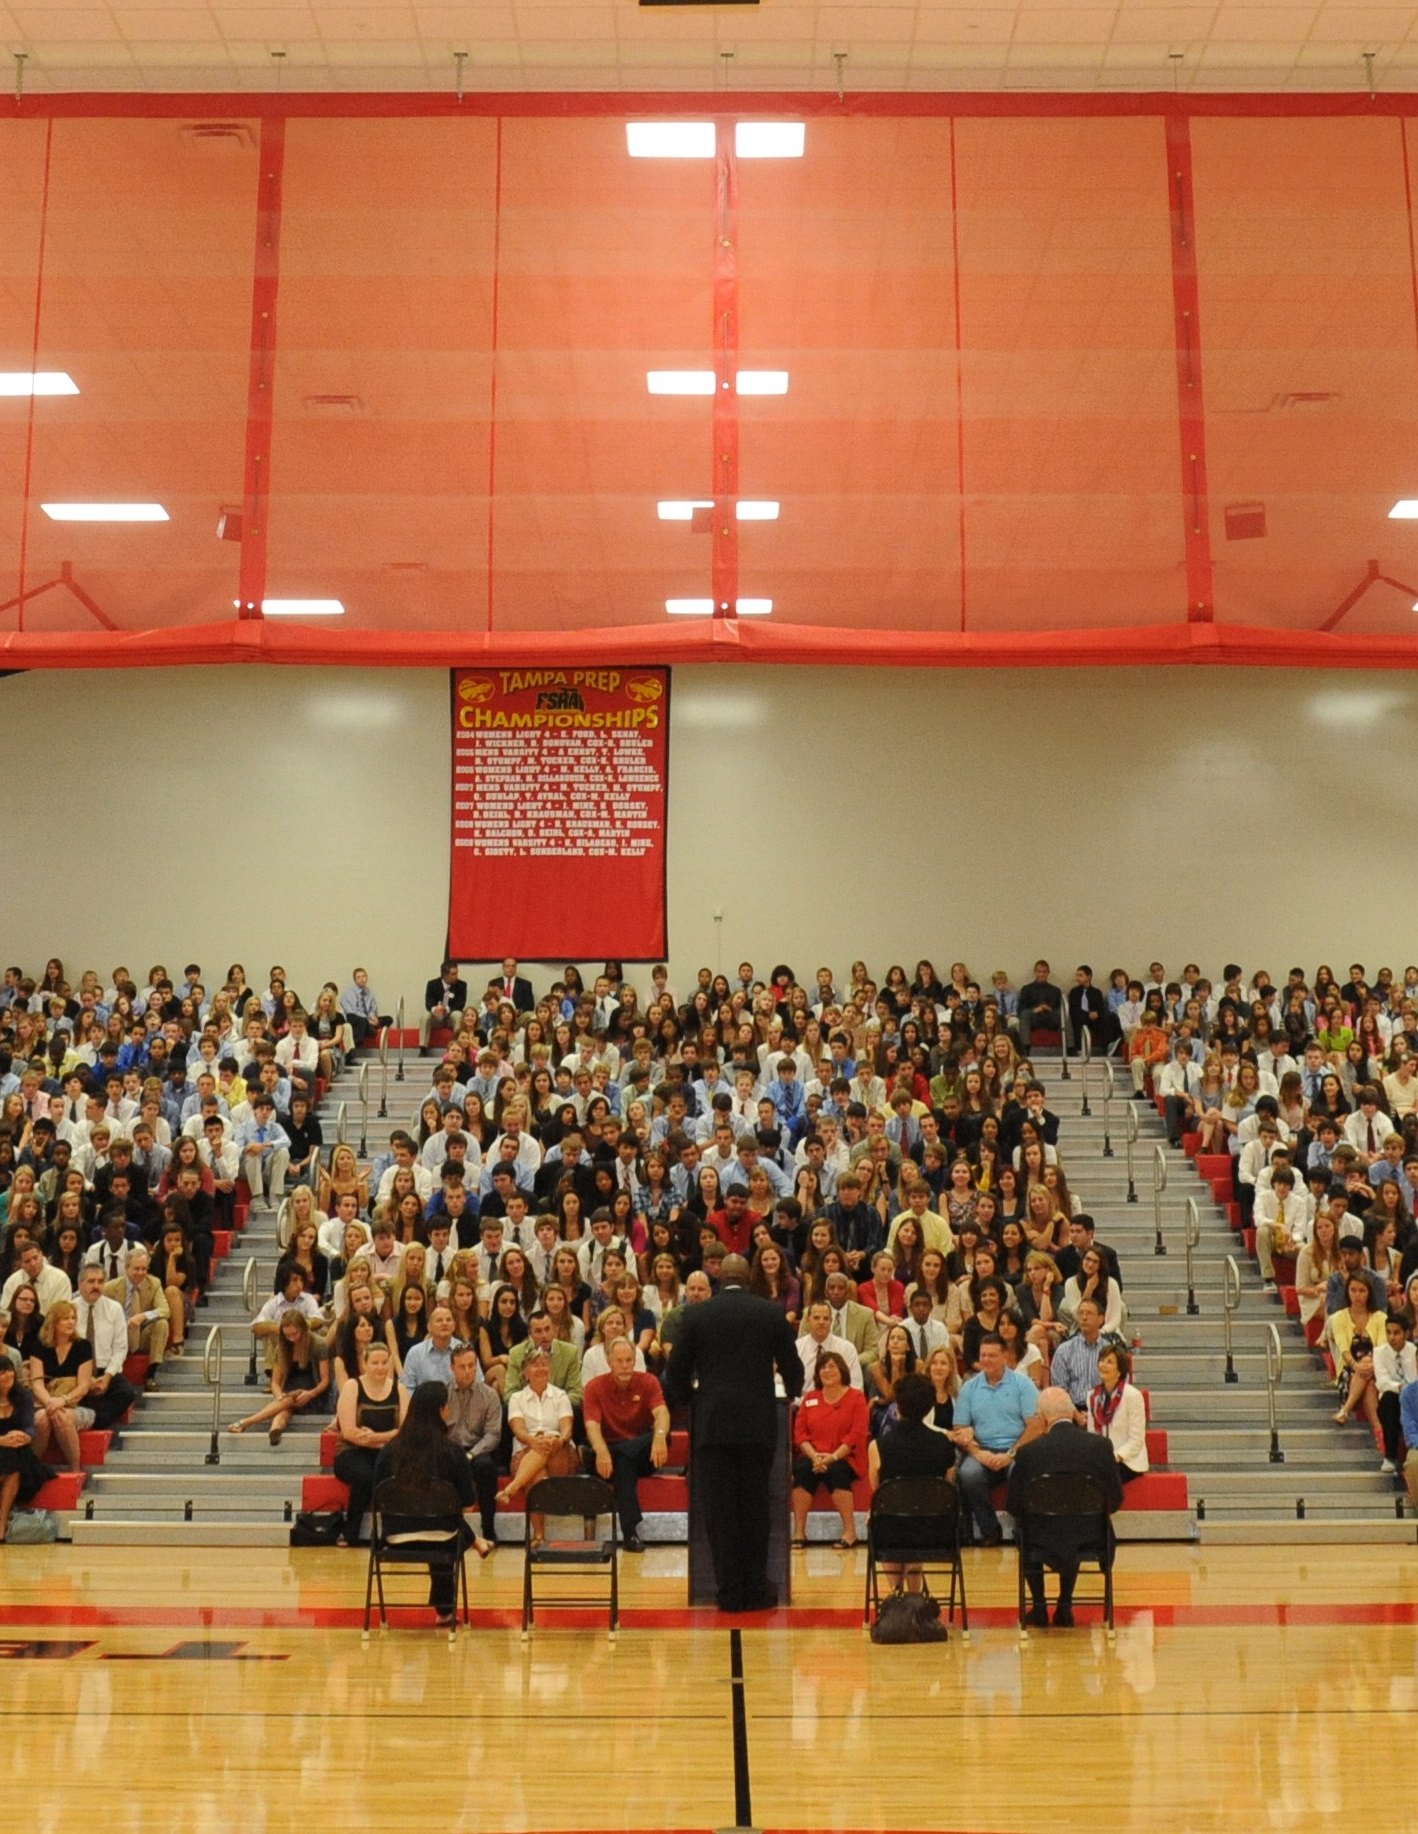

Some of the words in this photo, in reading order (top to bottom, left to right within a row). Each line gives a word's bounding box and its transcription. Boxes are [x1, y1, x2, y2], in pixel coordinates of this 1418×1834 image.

[500, 672, 566, 695] TAMPA
[573, 672, 620, 693] PREP
[459, 705, 659, 729] CHAMPIONSHIPS
